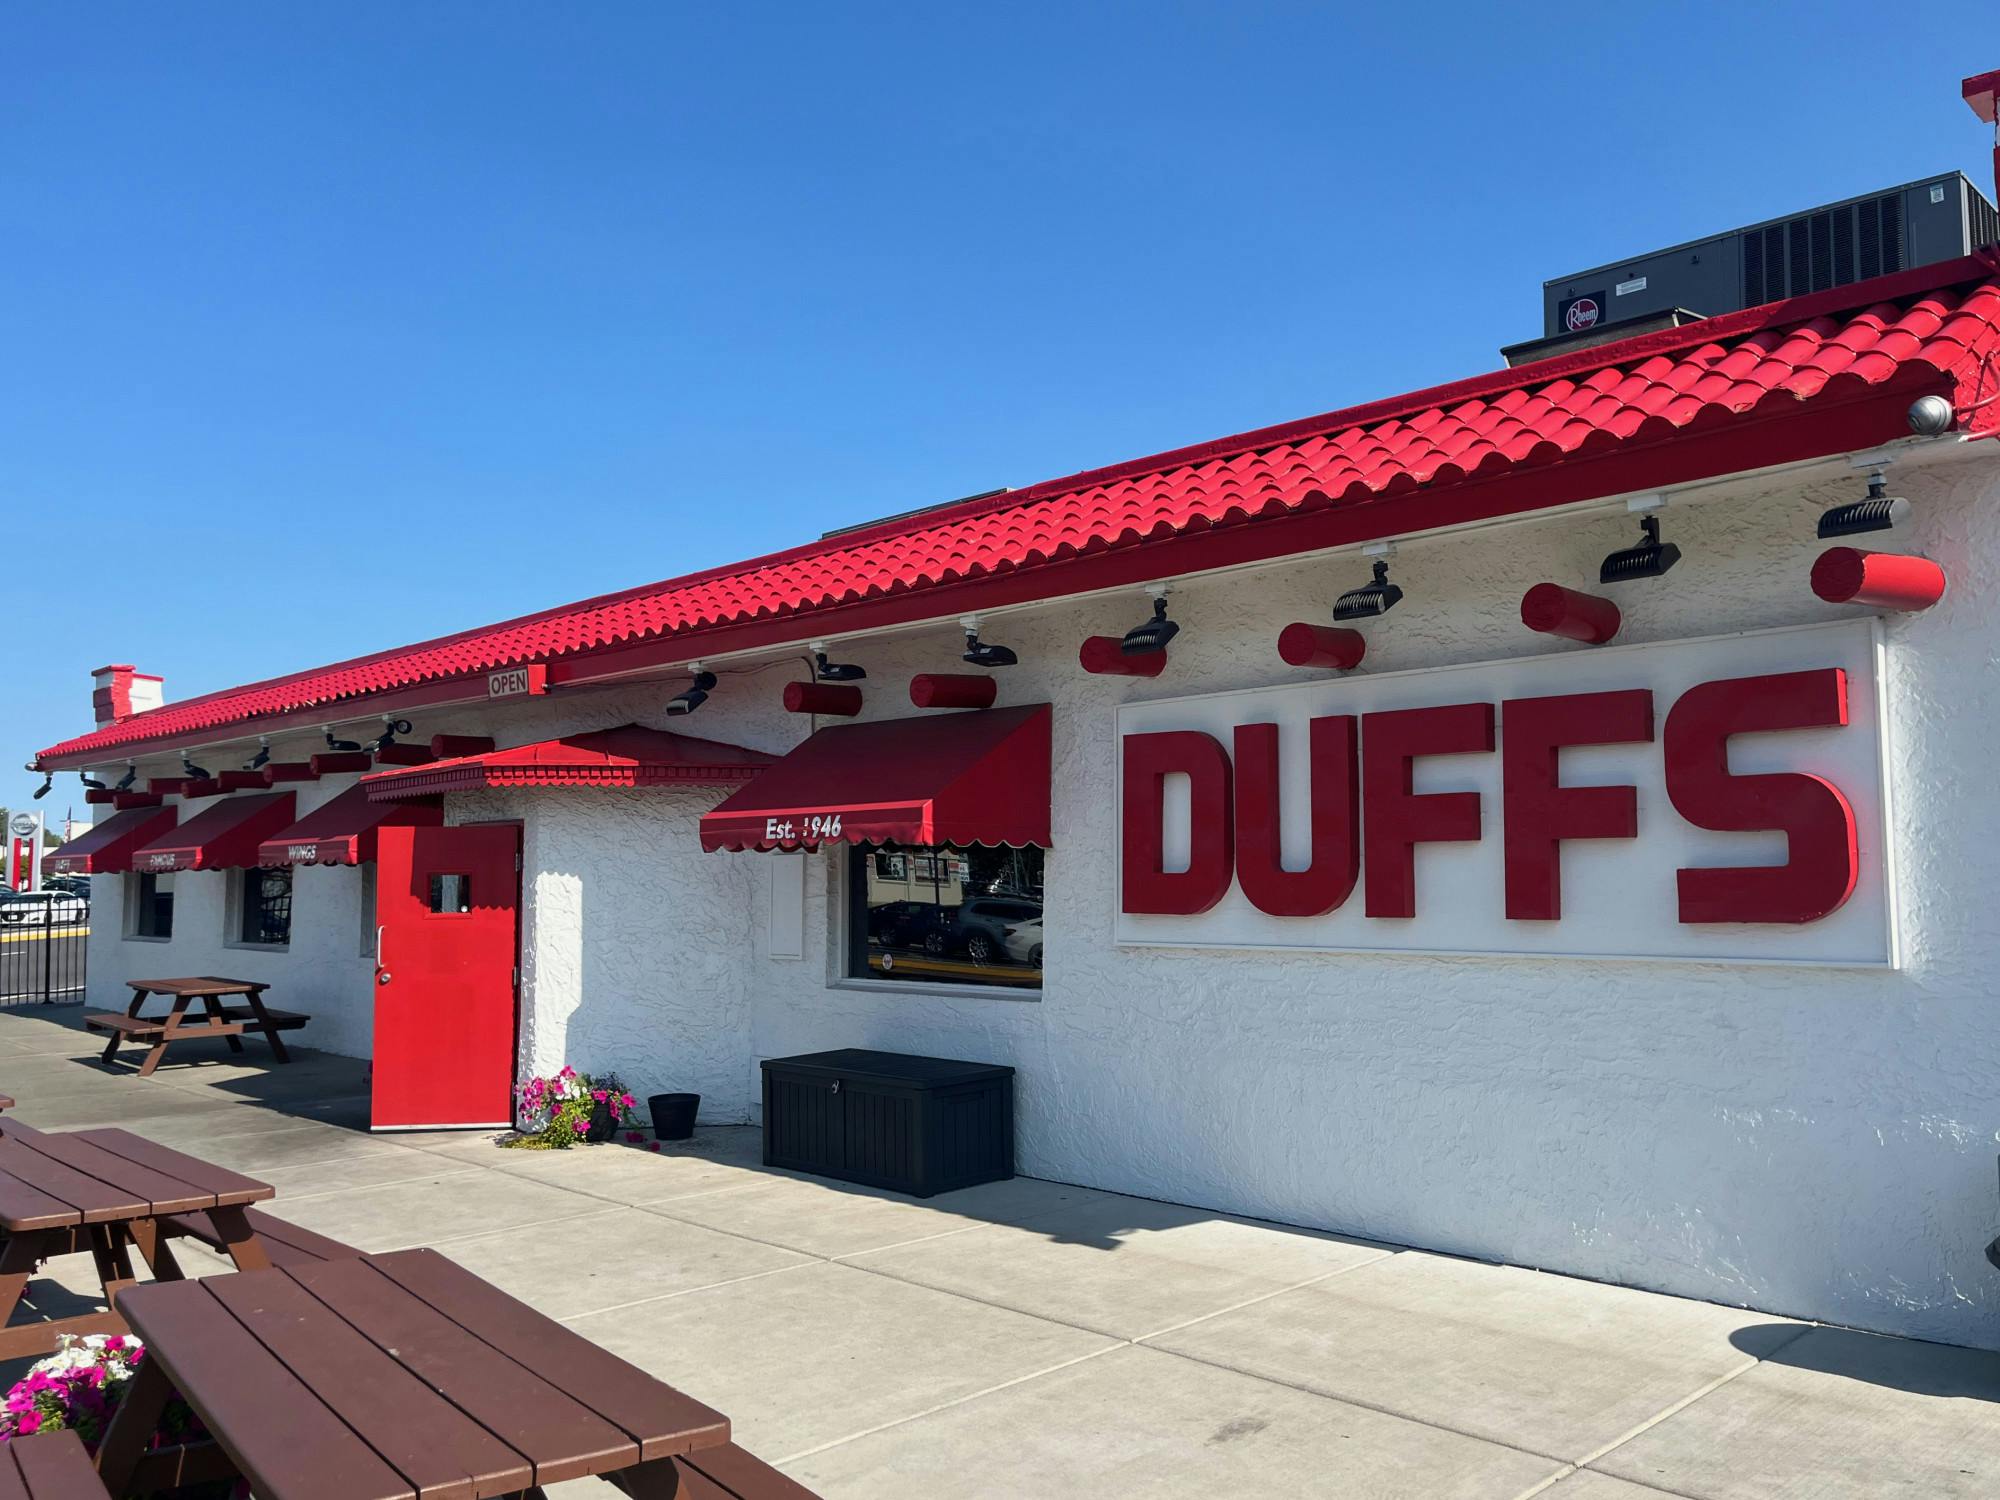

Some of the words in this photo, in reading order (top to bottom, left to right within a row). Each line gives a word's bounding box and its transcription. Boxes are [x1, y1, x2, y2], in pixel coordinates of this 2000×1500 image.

[1570, 301, 1596, 327] Rheem
[491, 671, 526, 694] OPEN
[1122, 667, 1859, 924] DUFFS
[766, 819, 796, 840] Est.
[802, 815, 841, 838] 1946
[288, 844, 317, 859] WINGS
